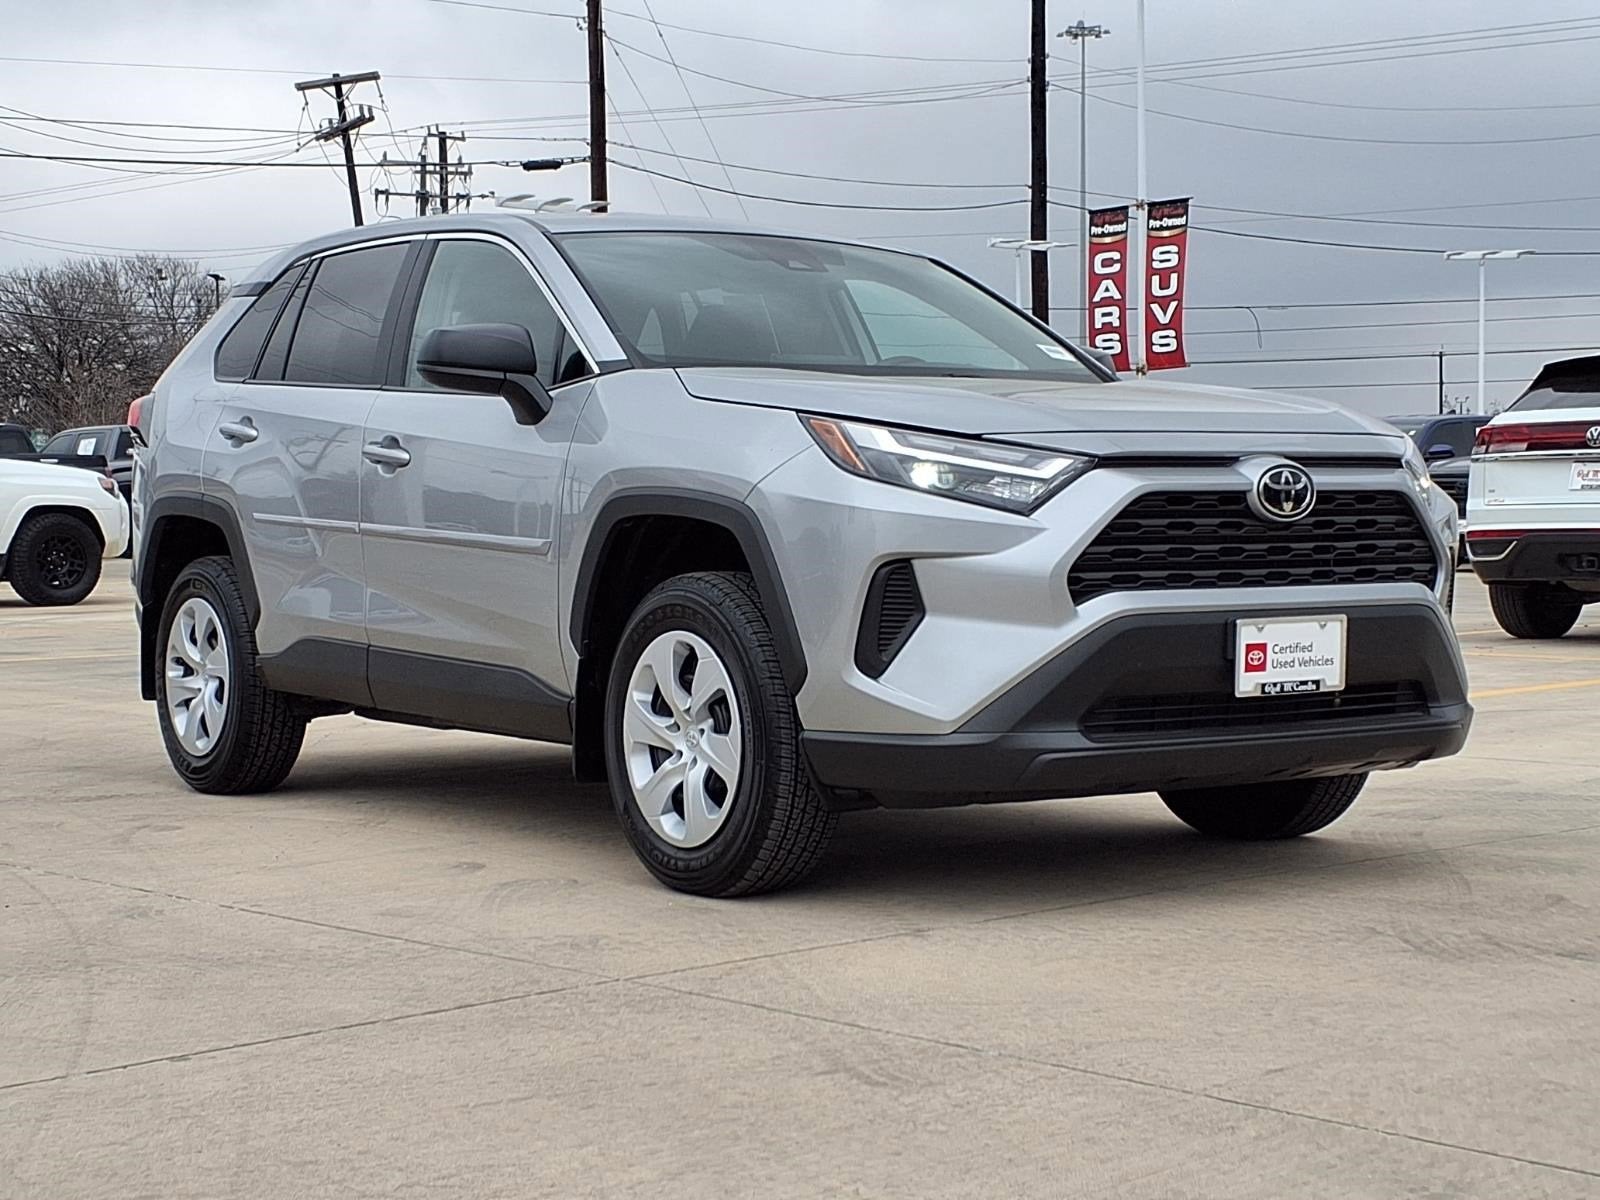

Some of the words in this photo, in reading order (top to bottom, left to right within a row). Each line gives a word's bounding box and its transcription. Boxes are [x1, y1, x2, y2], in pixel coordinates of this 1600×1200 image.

[1091, 221, 1127, 236] Pre-Owned
[1148, 215, 1186, 229] Pre-Owned
[1093, 251, 1122, 355] CARS
[1149, 245, 1179, 353] SUVS
[1272, 642, 1313, 654] Certified
[1271, 658, 1295, 669] Used
[1297, 656, 1334, 667] Vehicles
